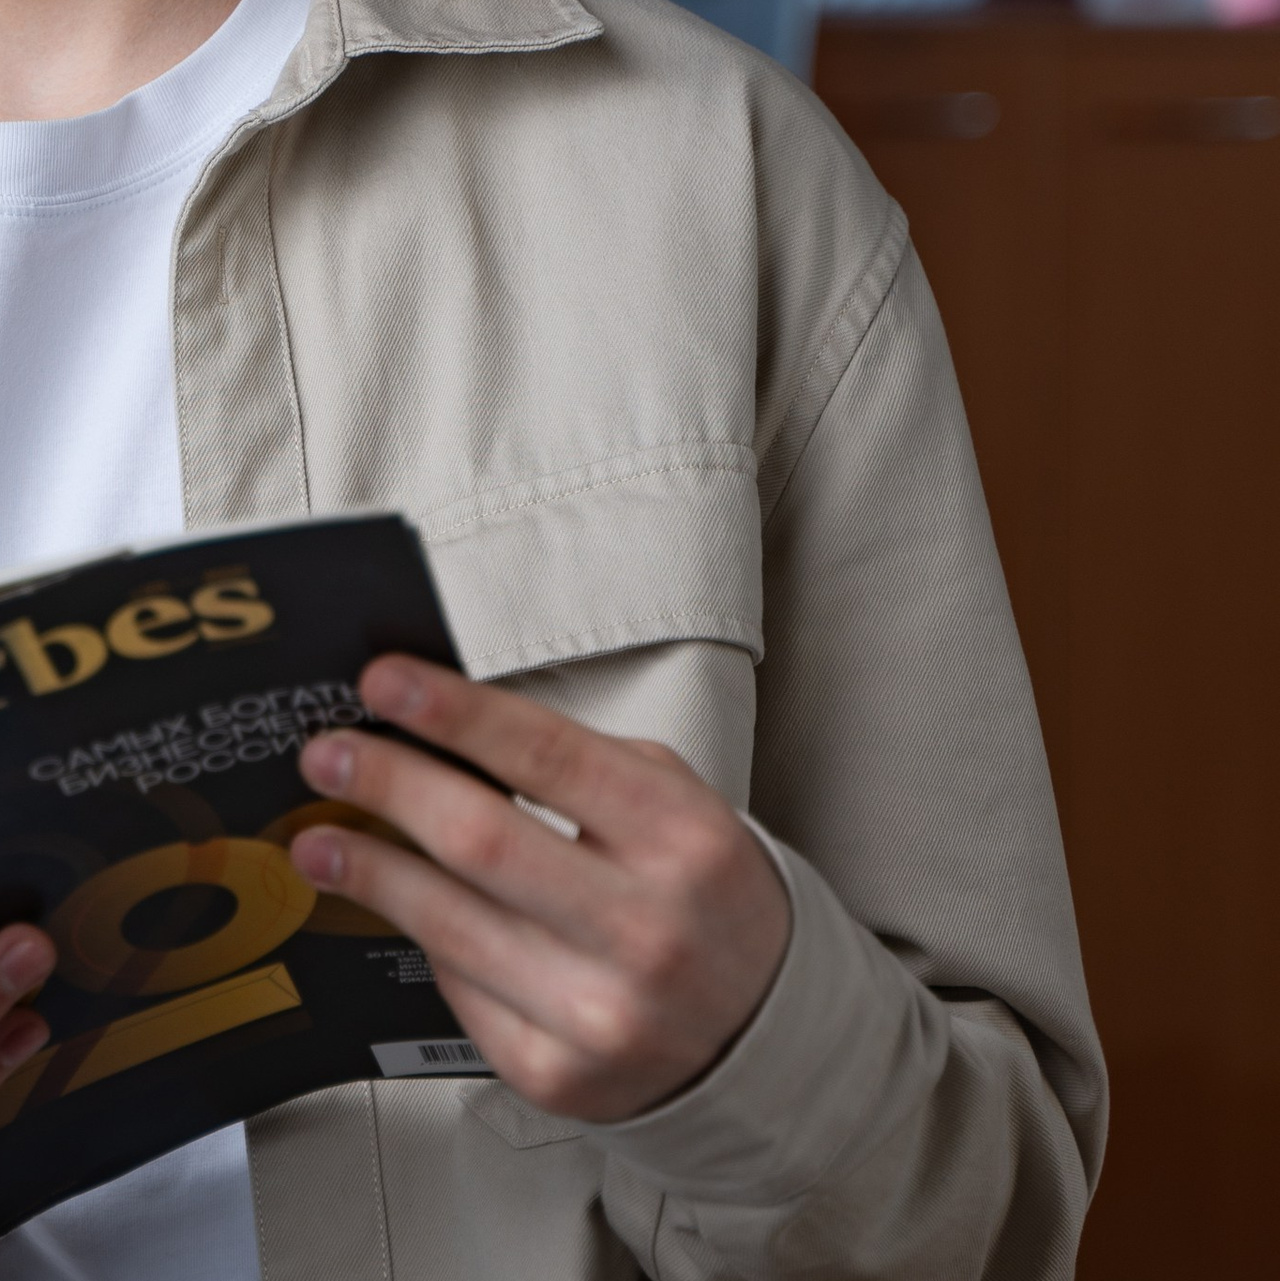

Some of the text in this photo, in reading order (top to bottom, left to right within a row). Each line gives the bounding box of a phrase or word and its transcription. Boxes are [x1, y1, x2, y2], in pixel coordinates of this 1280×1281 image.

[29, 714, 193, 781] САМЫХ
[58, 704, 375, 797] БИЗНЕСМЕНО
[136, 733, 305, 794] РОССИ
